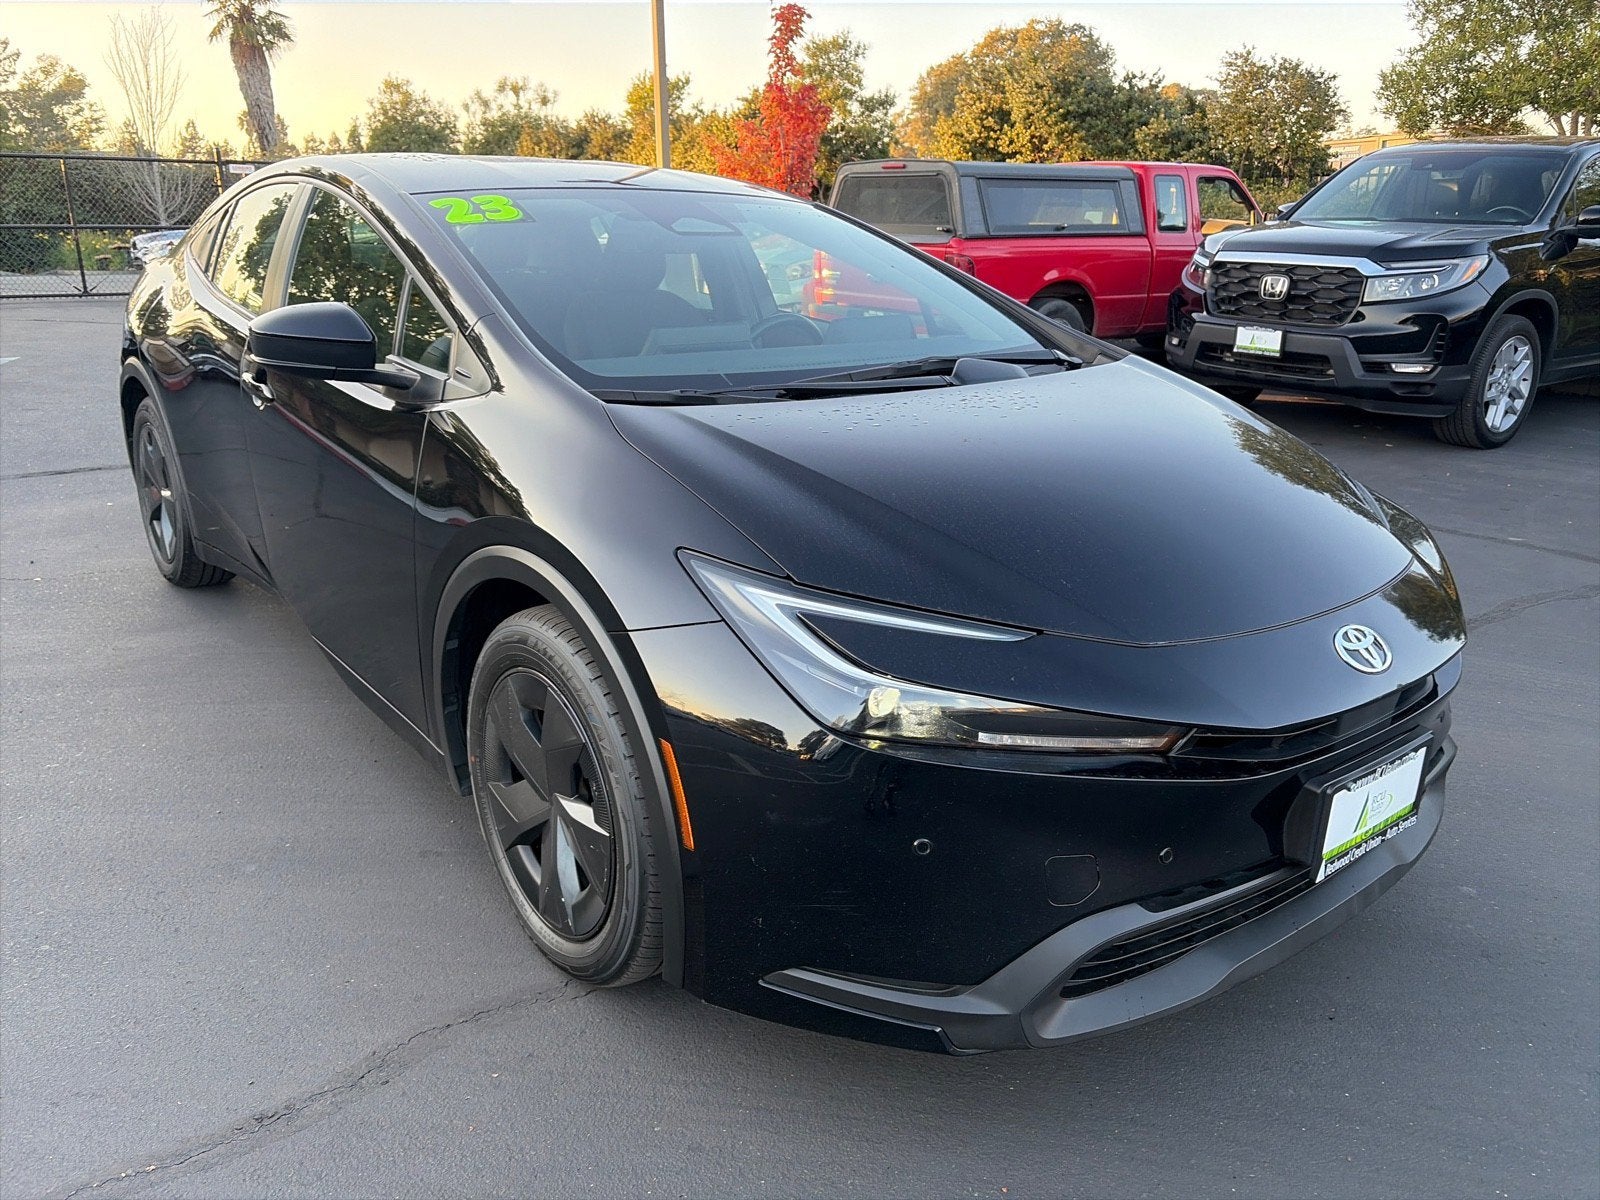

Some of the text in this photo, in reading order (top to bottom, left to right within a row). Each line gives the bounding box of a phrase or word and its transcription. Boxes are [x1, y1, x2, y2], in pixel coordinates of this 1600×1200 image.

[428, 195, 523, 224] 23
[1326, 851, 1352, 875] Redwood
[1351, 842, 1367, 861] Credit
[1366, 835, 1382, 852] Union
[1385, 826, 1399, 841] Auto
